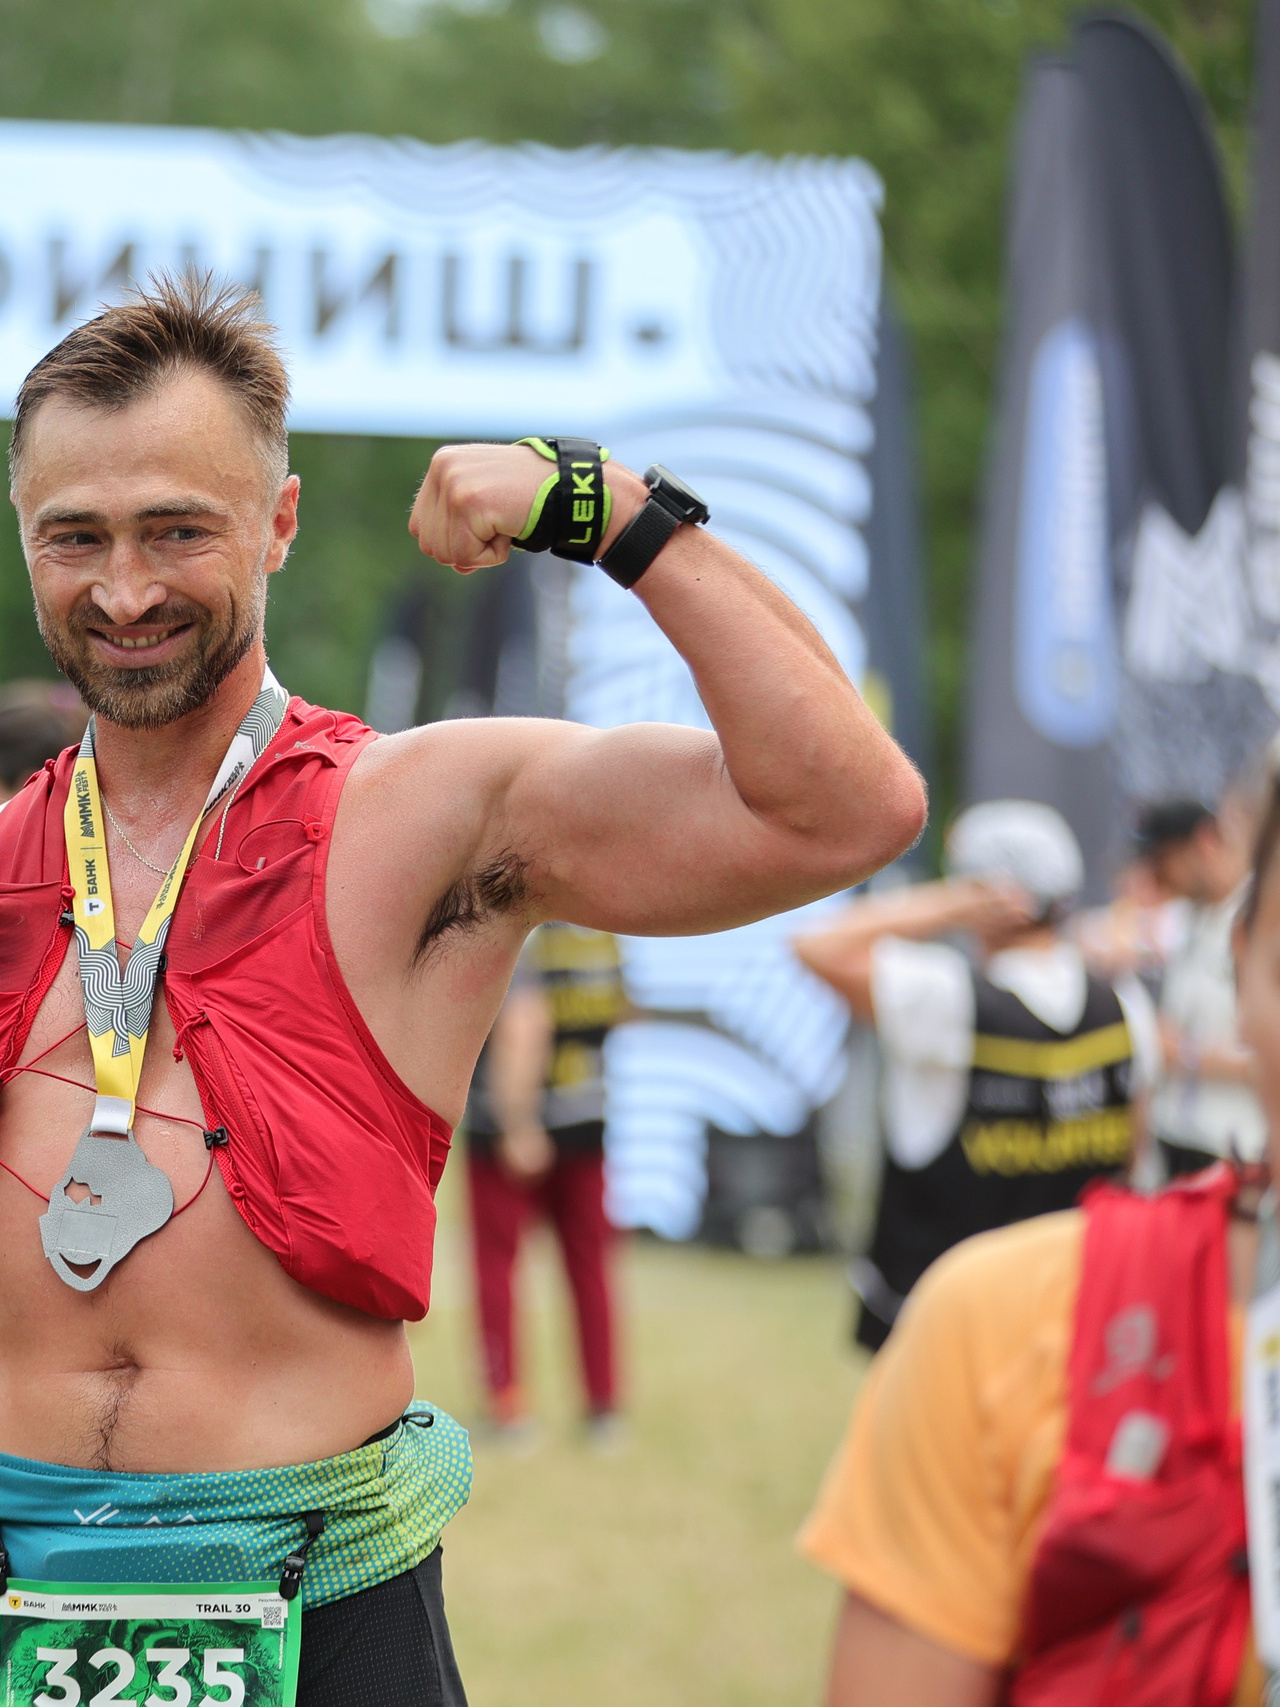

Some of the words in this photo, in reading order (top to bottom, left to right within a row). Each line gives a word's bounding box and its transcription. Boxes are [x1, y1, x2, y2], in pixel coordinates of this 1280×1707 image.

[569, 462, 596, 544] LEKI
[81, 776, 89, 791] FEST
[85, 859, 98, 896] БАНК
[24, 1600, 46, 1609] БАНК
[196, 1604, 232, 1613] TRAIL
[235, 1603, 251, 1613] 30
[33, 1647, 246, 1707] 3235
